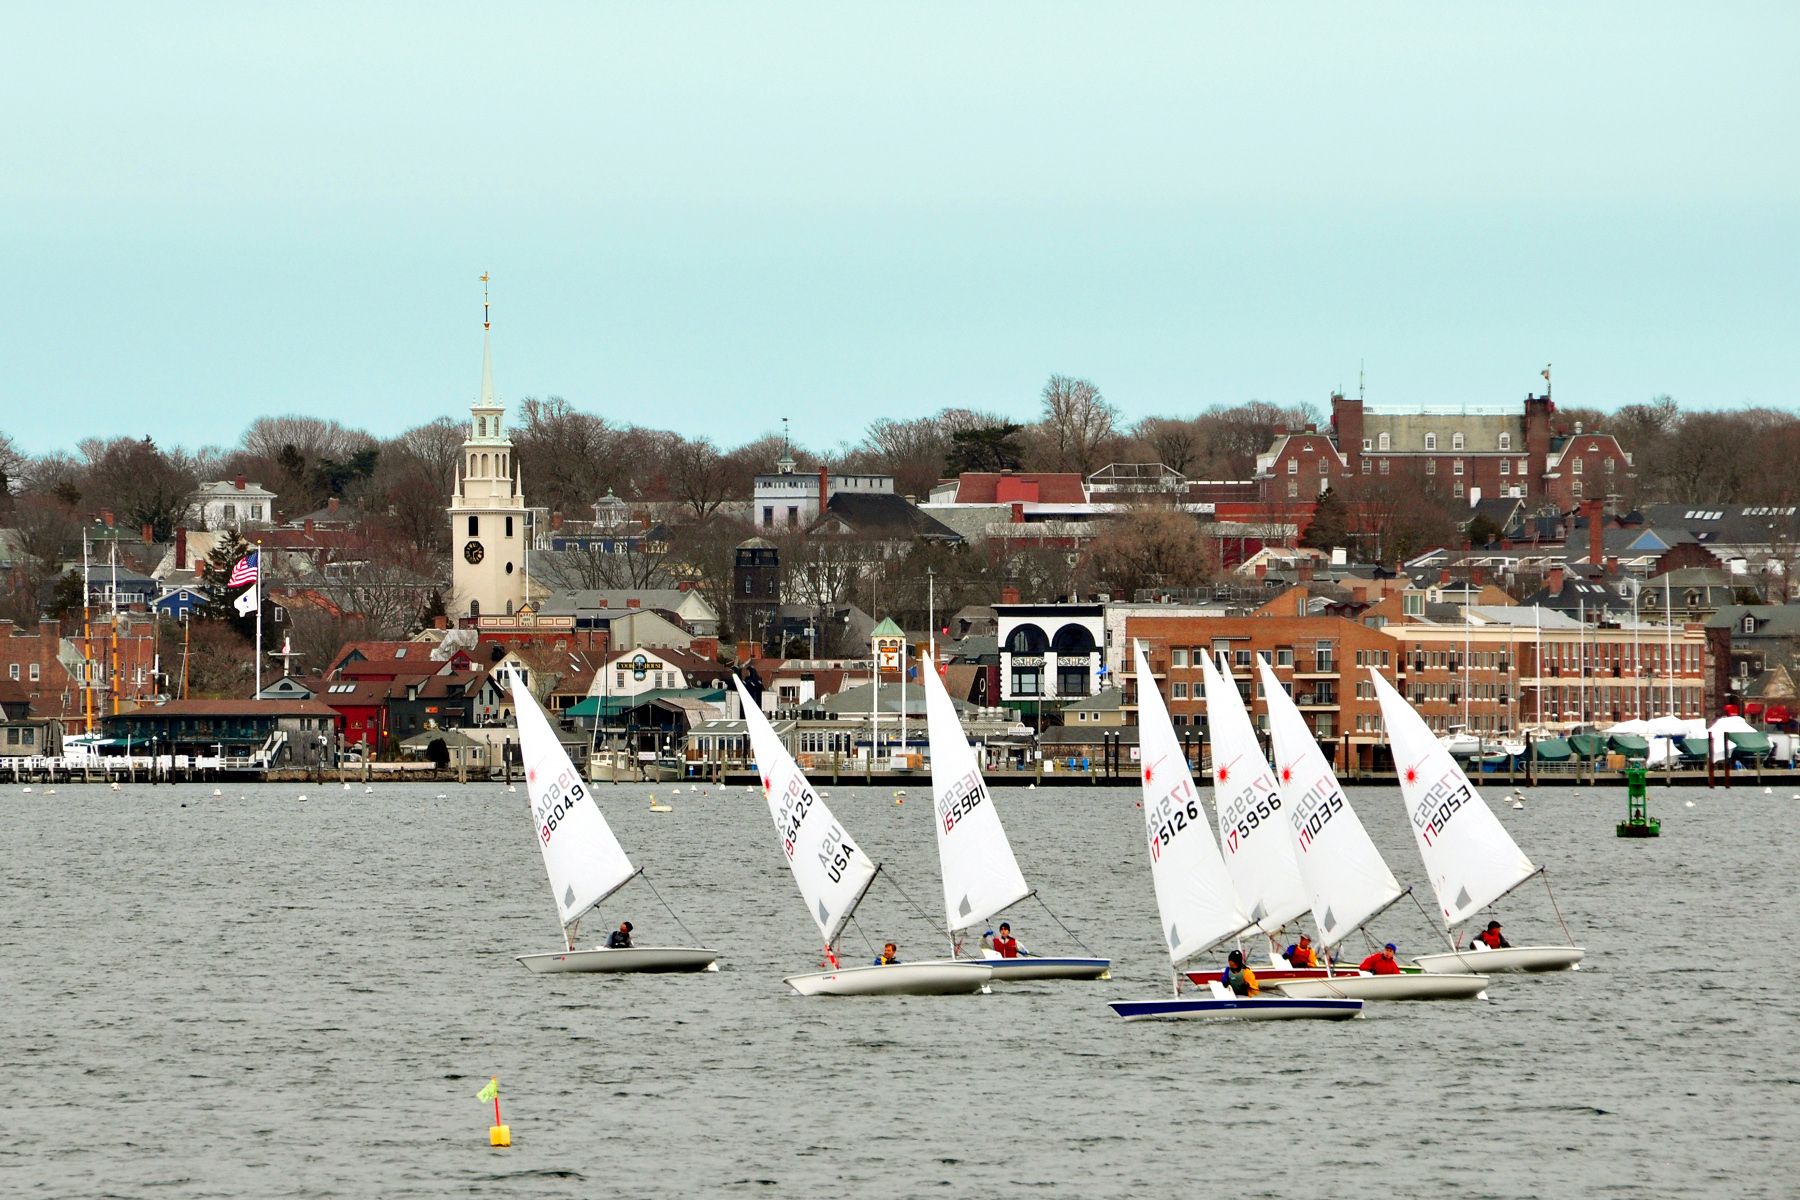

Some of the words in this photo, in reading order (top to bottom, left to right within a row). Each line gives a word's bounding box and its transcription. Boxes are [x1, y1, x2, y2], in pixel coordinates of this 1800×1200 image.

[541, 784, 584, 847] 196049
[786, 789, 813, 861] 195425
[943, 784, 985, 835] 165981
[1151, 801, 1198, 863] 175126
[1227, 792, 1281, 854] 175956
[1299, 791, 1343, 853] 171035
[1423, 784, 1471, 847] 175053
[828, 843, 854, 884] USA
